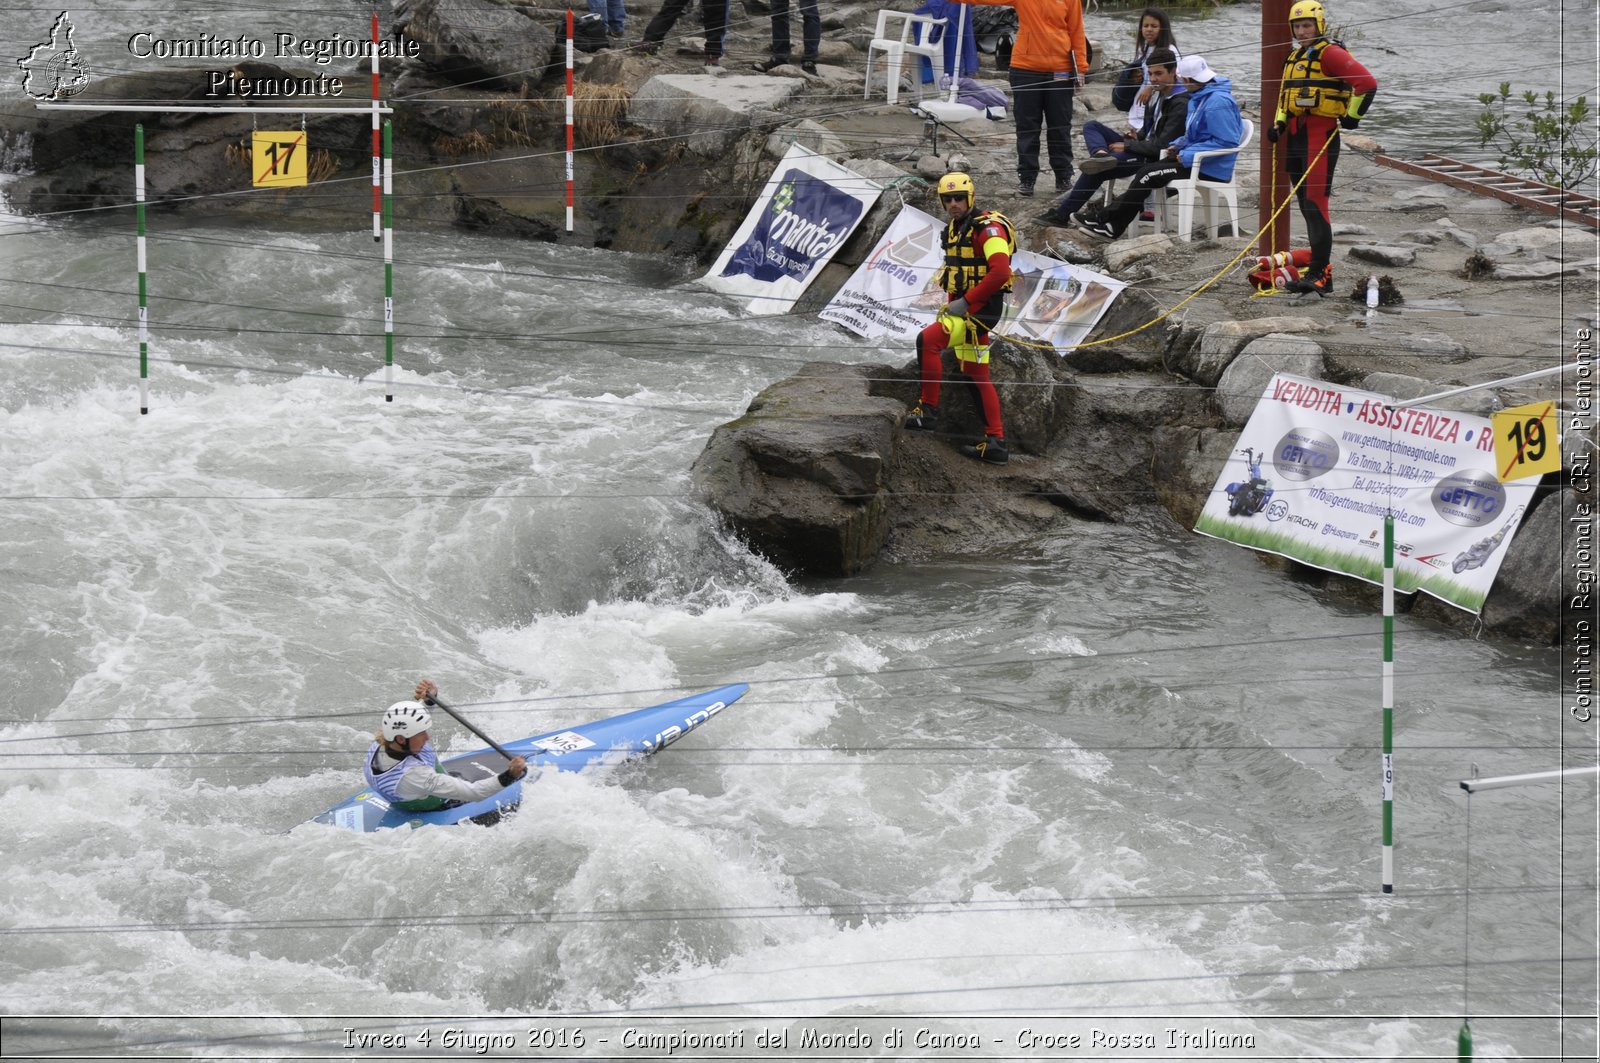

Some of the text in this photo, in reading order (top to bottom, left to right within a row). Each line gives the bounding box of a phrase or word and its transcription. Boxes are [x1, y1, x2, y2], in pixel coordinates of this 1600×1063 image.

[265, 142, 297, 175] 17
[770, 209, 848, 259] manital
[1272, 378, 1342, 416] VENDITA
[1356, 399, 1460, 443] ASSISTENZA
[1280, 444, 1328, 468] GETTO
[1342, 430, 1457, 467] www.gettomacchineagricole.com
[1507, 418, 1546, 465] 19
[1346, 451, 1359, 466] Via
[1359, 454, 1382, 473] Torino,
[1383, 461, 1393, 475] 26
[1396, 464, 1419, 481] IVREA
[1267, 503, 1287, 517] BCS
[1440, 487, 1497, 513] GETTO
[1286, 513, 1319, 530] HITACHI
